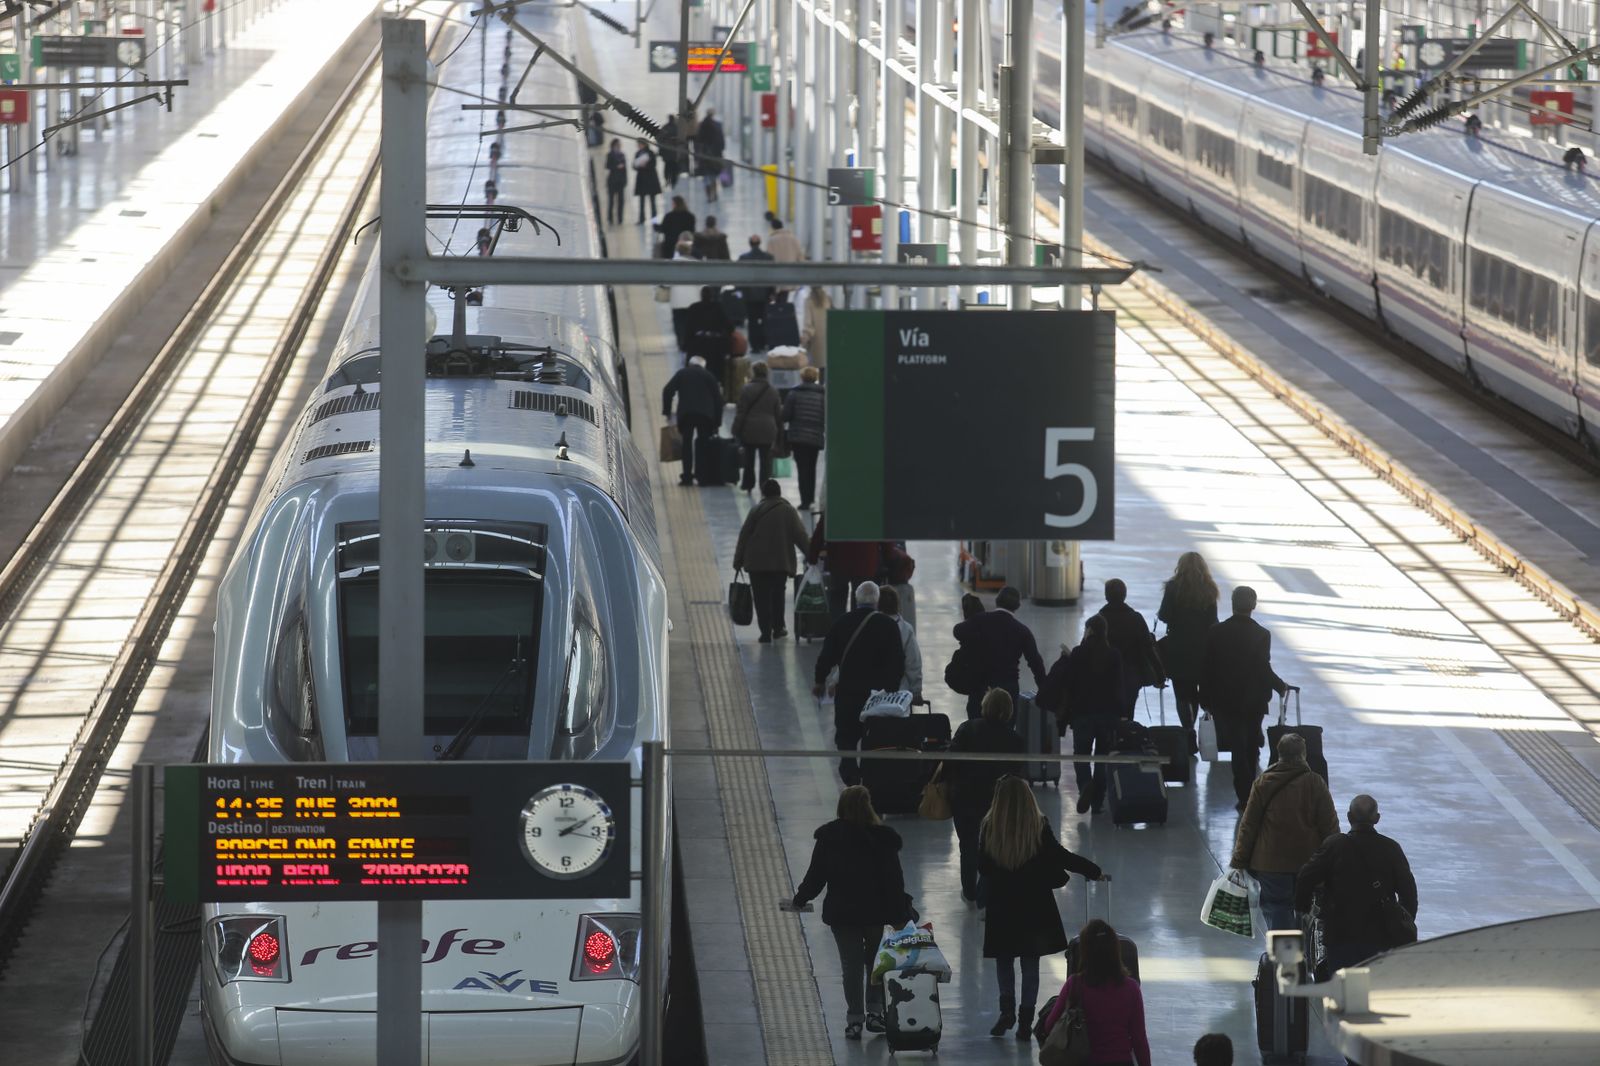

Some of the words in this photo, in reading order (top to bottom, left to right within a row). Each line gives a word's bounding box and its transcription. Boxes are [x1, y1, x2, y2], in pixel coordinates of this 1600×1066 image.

[829, 186, 840, 204] 5
[899, 327, 930, 347] Vía
[897, 355, 947, 365] PLATFORM
[1043, 426, 1098, 528] 5
[207, 777, 241, 789] Hora
[250, 780, 275, 789] TIME
[296, 776, 327, 789] Tren
[336, 780, 367, 789] TRAIN
[559, 797, 575, 808] 12
[208, 821, 263, 835] Destino
[272, 824, 326, 835] DESTINATION
[531, 827, 542, 838] 9
[591, 826, 601, 837] 3
[561, 856, 572, 867] 6
[300, 928, 505, 966] refe
[452, 969, 559, 994] AVE
